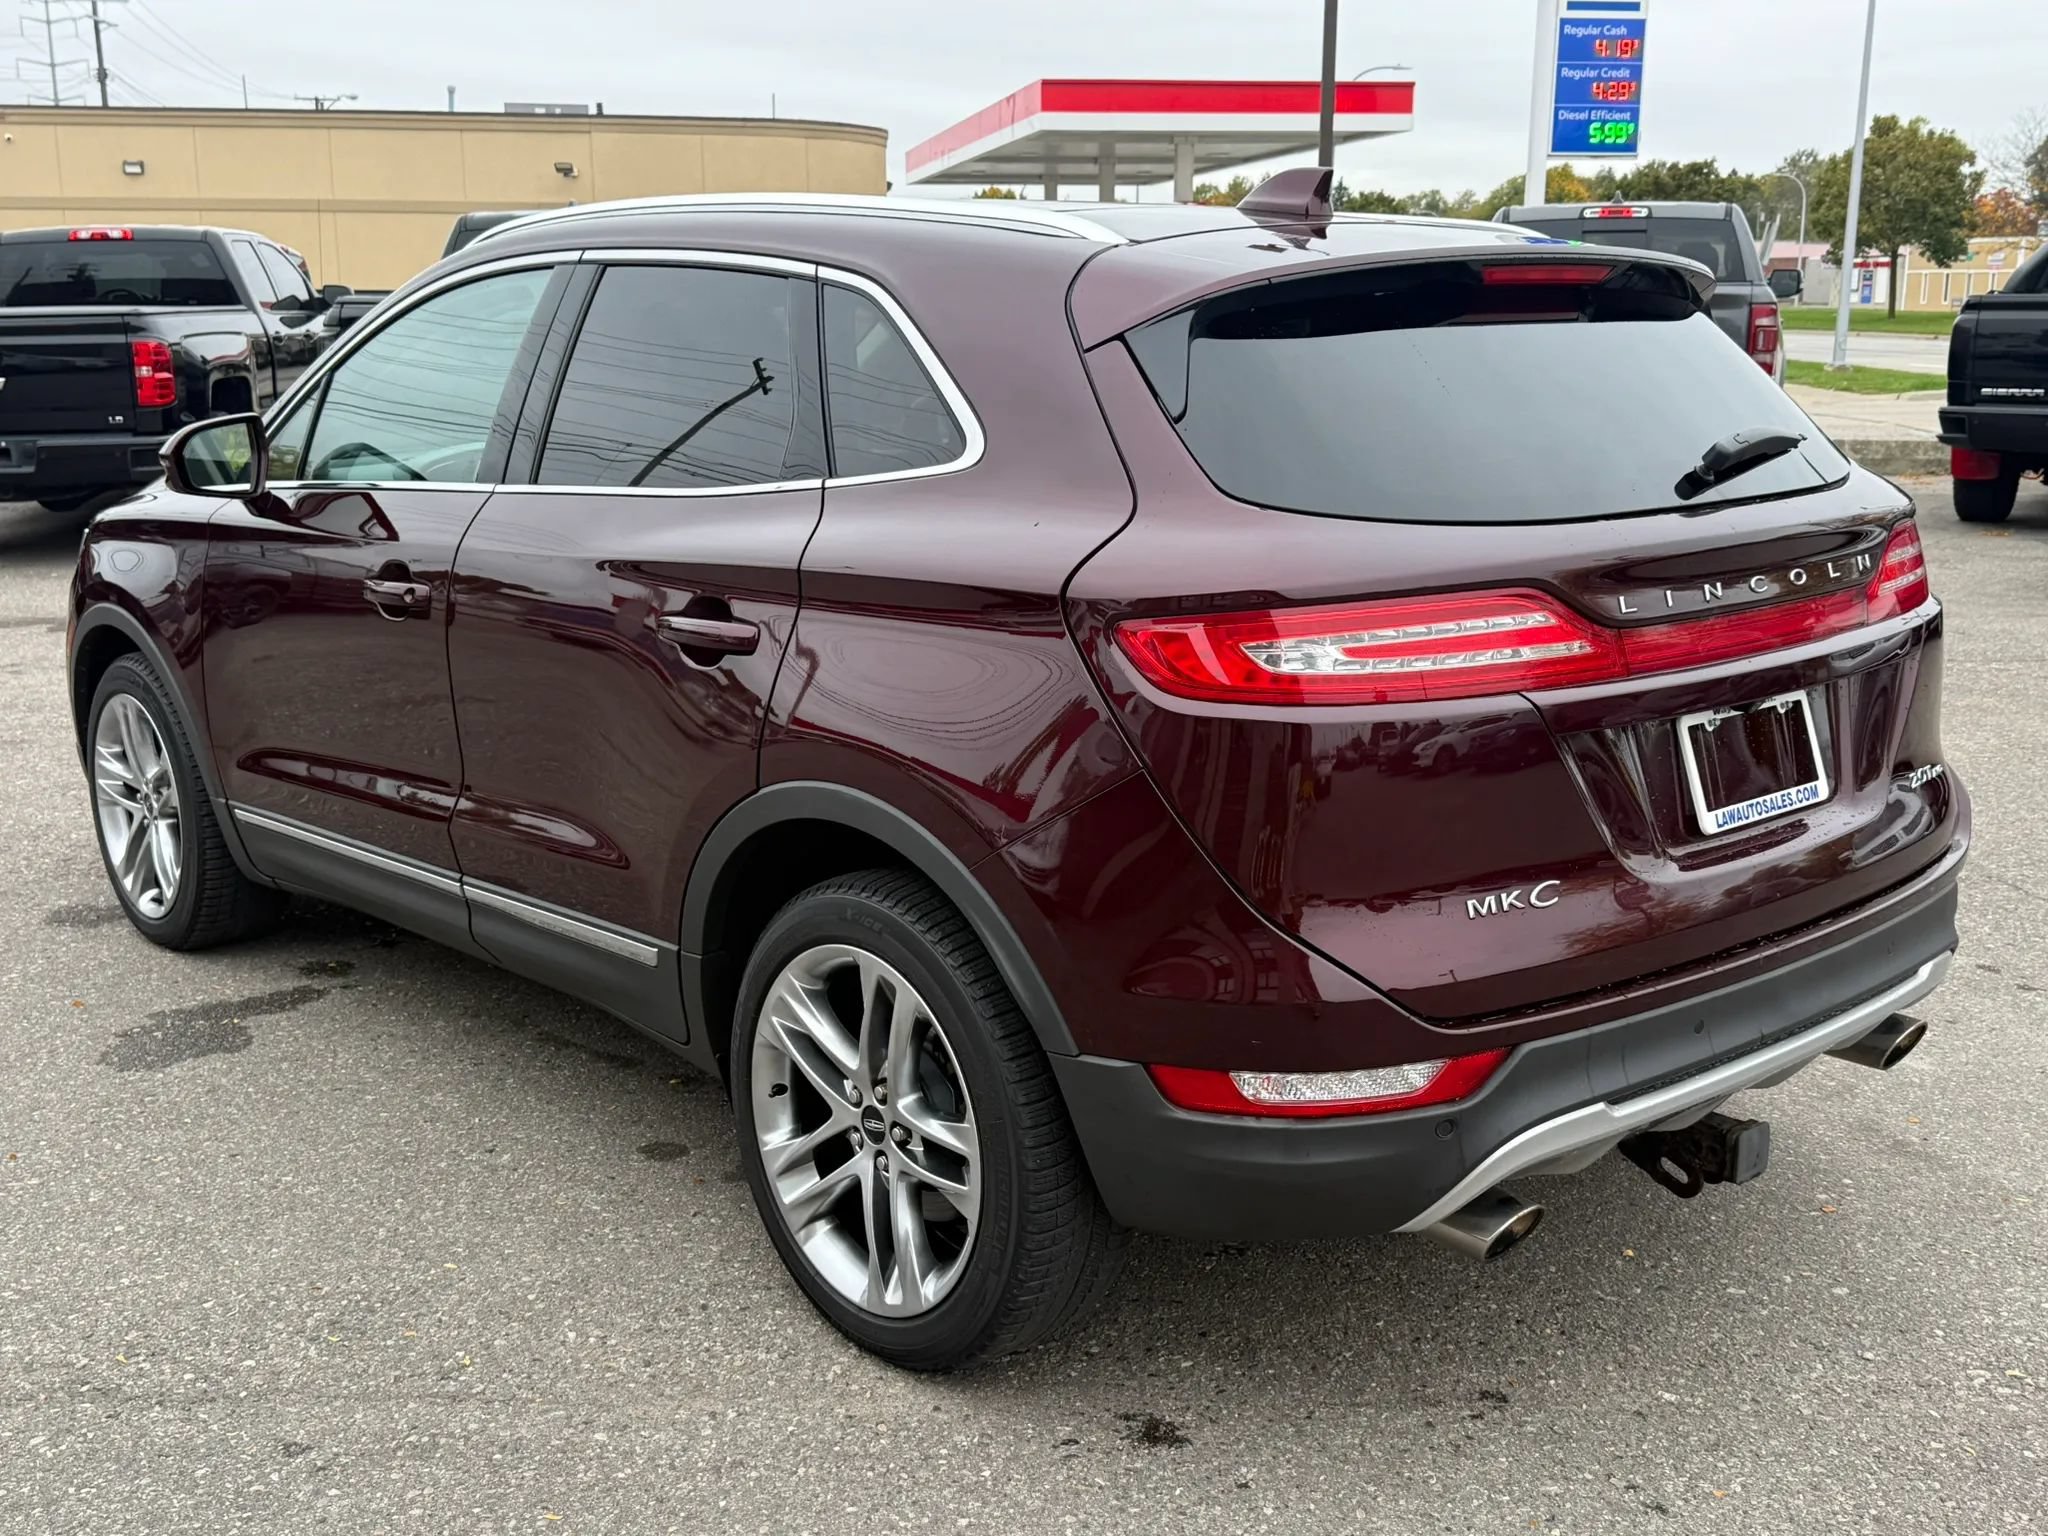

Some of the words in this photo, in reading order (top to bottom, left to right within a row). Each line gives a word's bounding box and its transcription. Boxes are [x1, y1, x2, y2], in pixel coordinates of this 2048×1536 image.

[1564, 25, 1600, 37] Regular
[1603, 25, 1627, 35] Cash
[1561, 67, 1598, 80] Regular
[1601, 67, 1630, 78] Credit
[1558, 110, 1588, 120] Diesel
[1591, 110, 1631, 121] Efficient
[1618, 553, 1872, 615] LINCOLN
[1715, 784, 1819, 828] LAWAUTOSALES.COM
[1466, 880, 1560, 919] MKC
